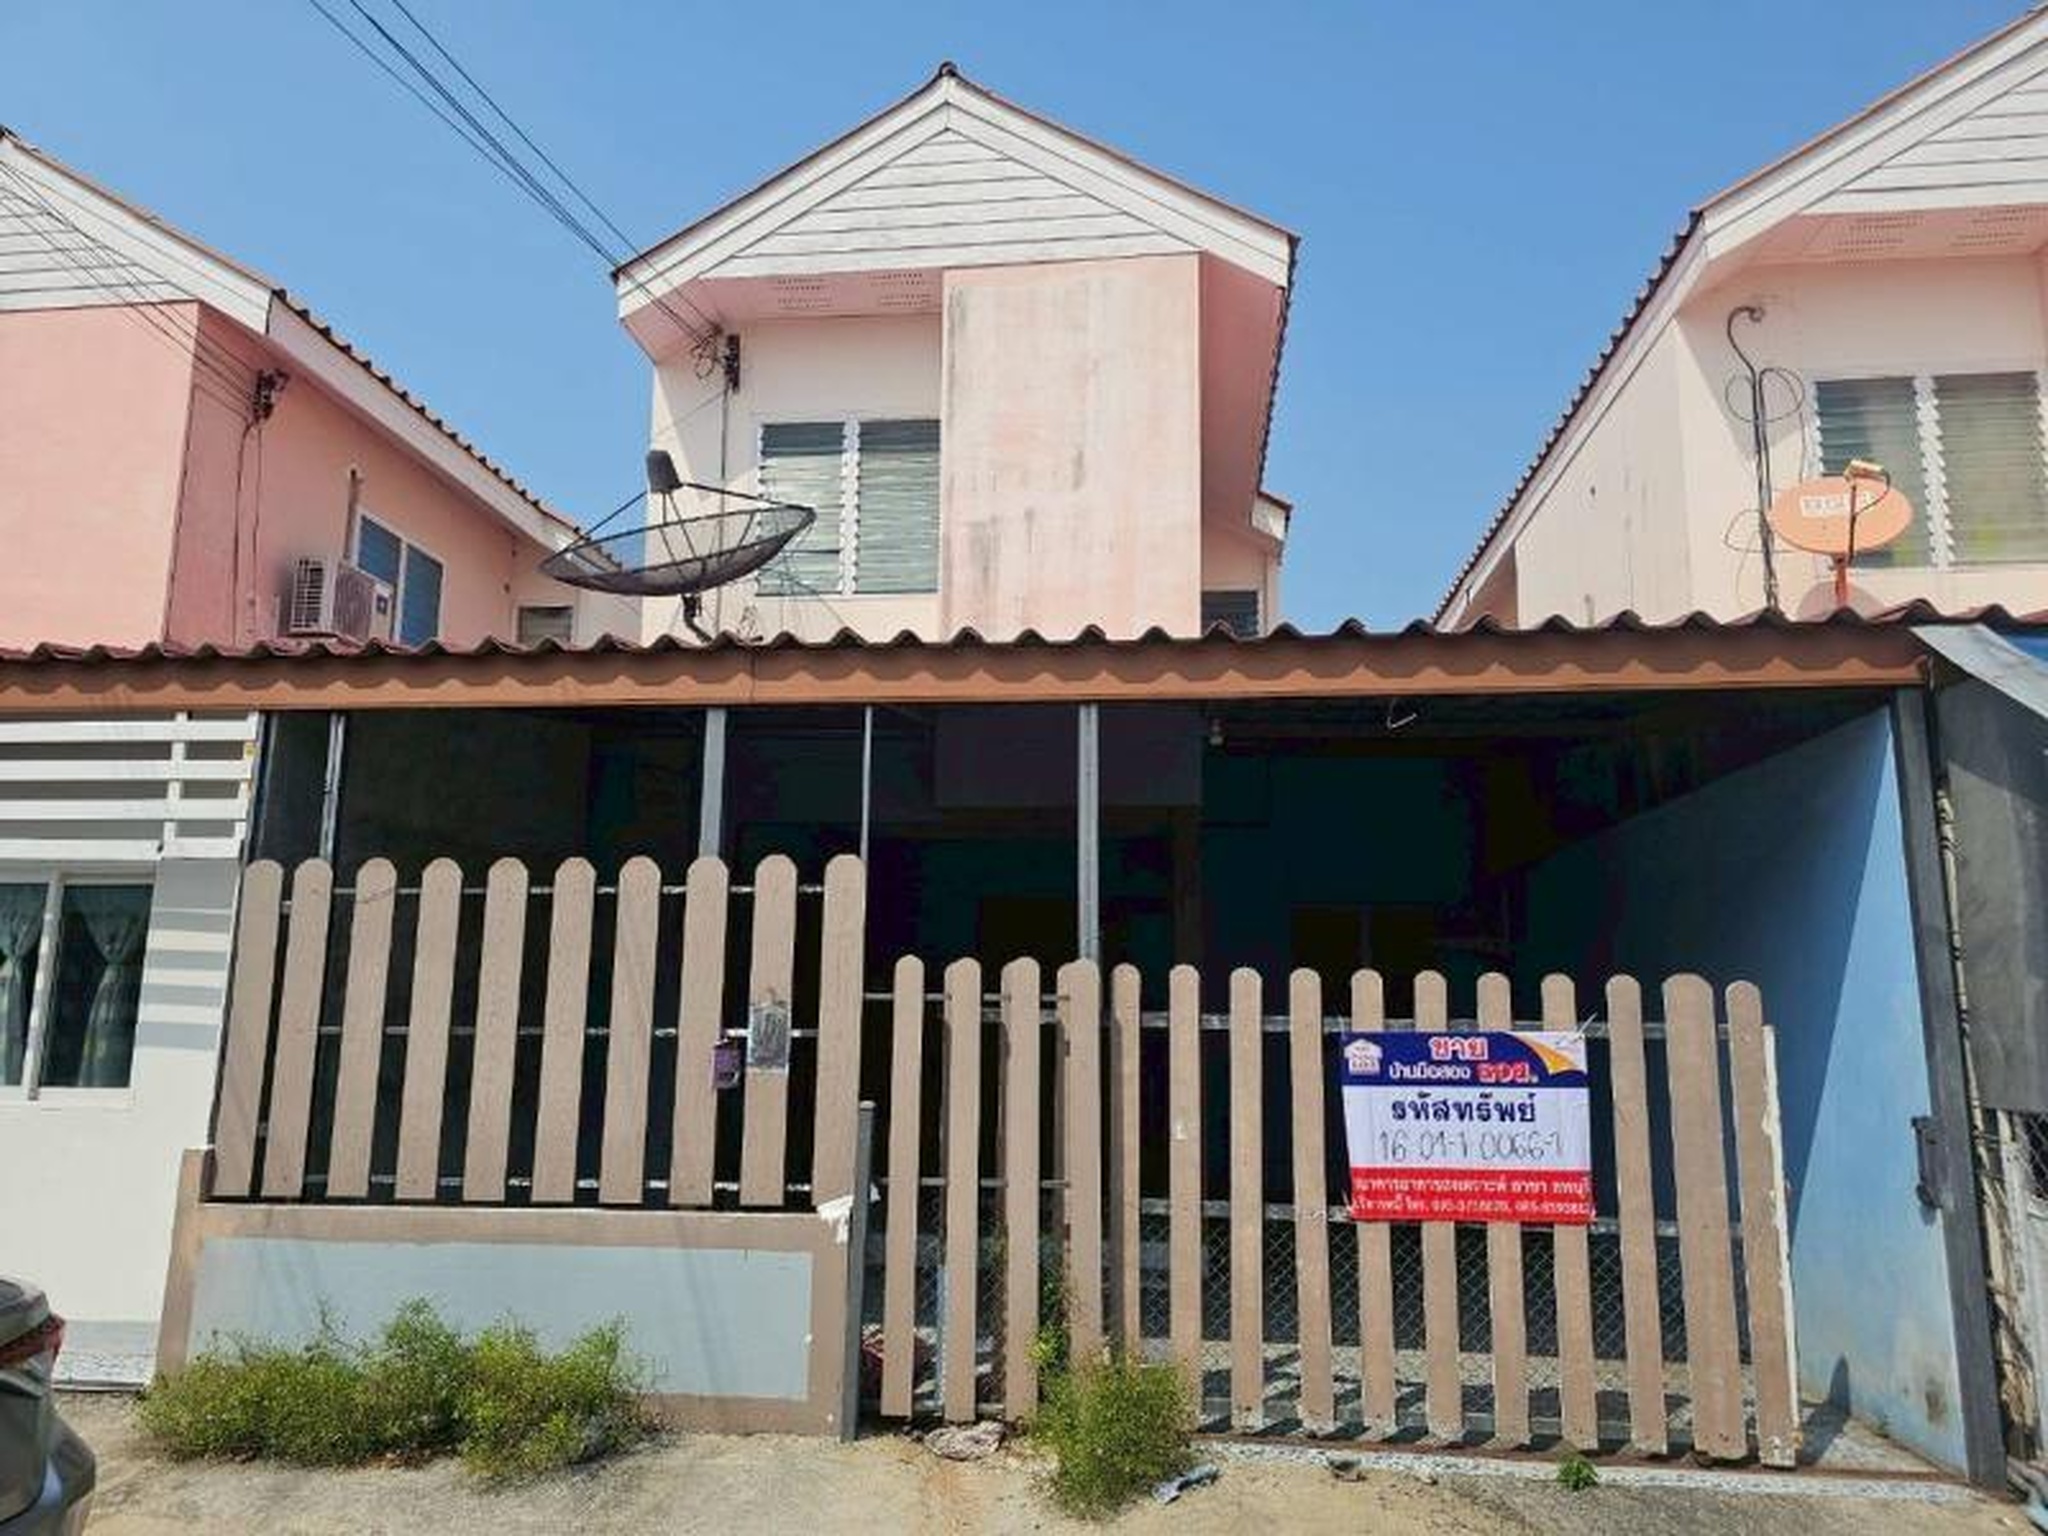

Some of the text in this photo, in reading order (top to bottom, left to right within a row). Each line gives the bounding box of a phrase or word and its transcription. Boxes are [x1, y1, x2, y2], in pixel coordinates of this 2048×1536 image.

[1428, 1036, 1489, 1060] ขาย
[1388, 1061, 1471, 1080] บ้านมือสอง
[1391, 1091, 1537, 1122] รหัสทรัพย์
